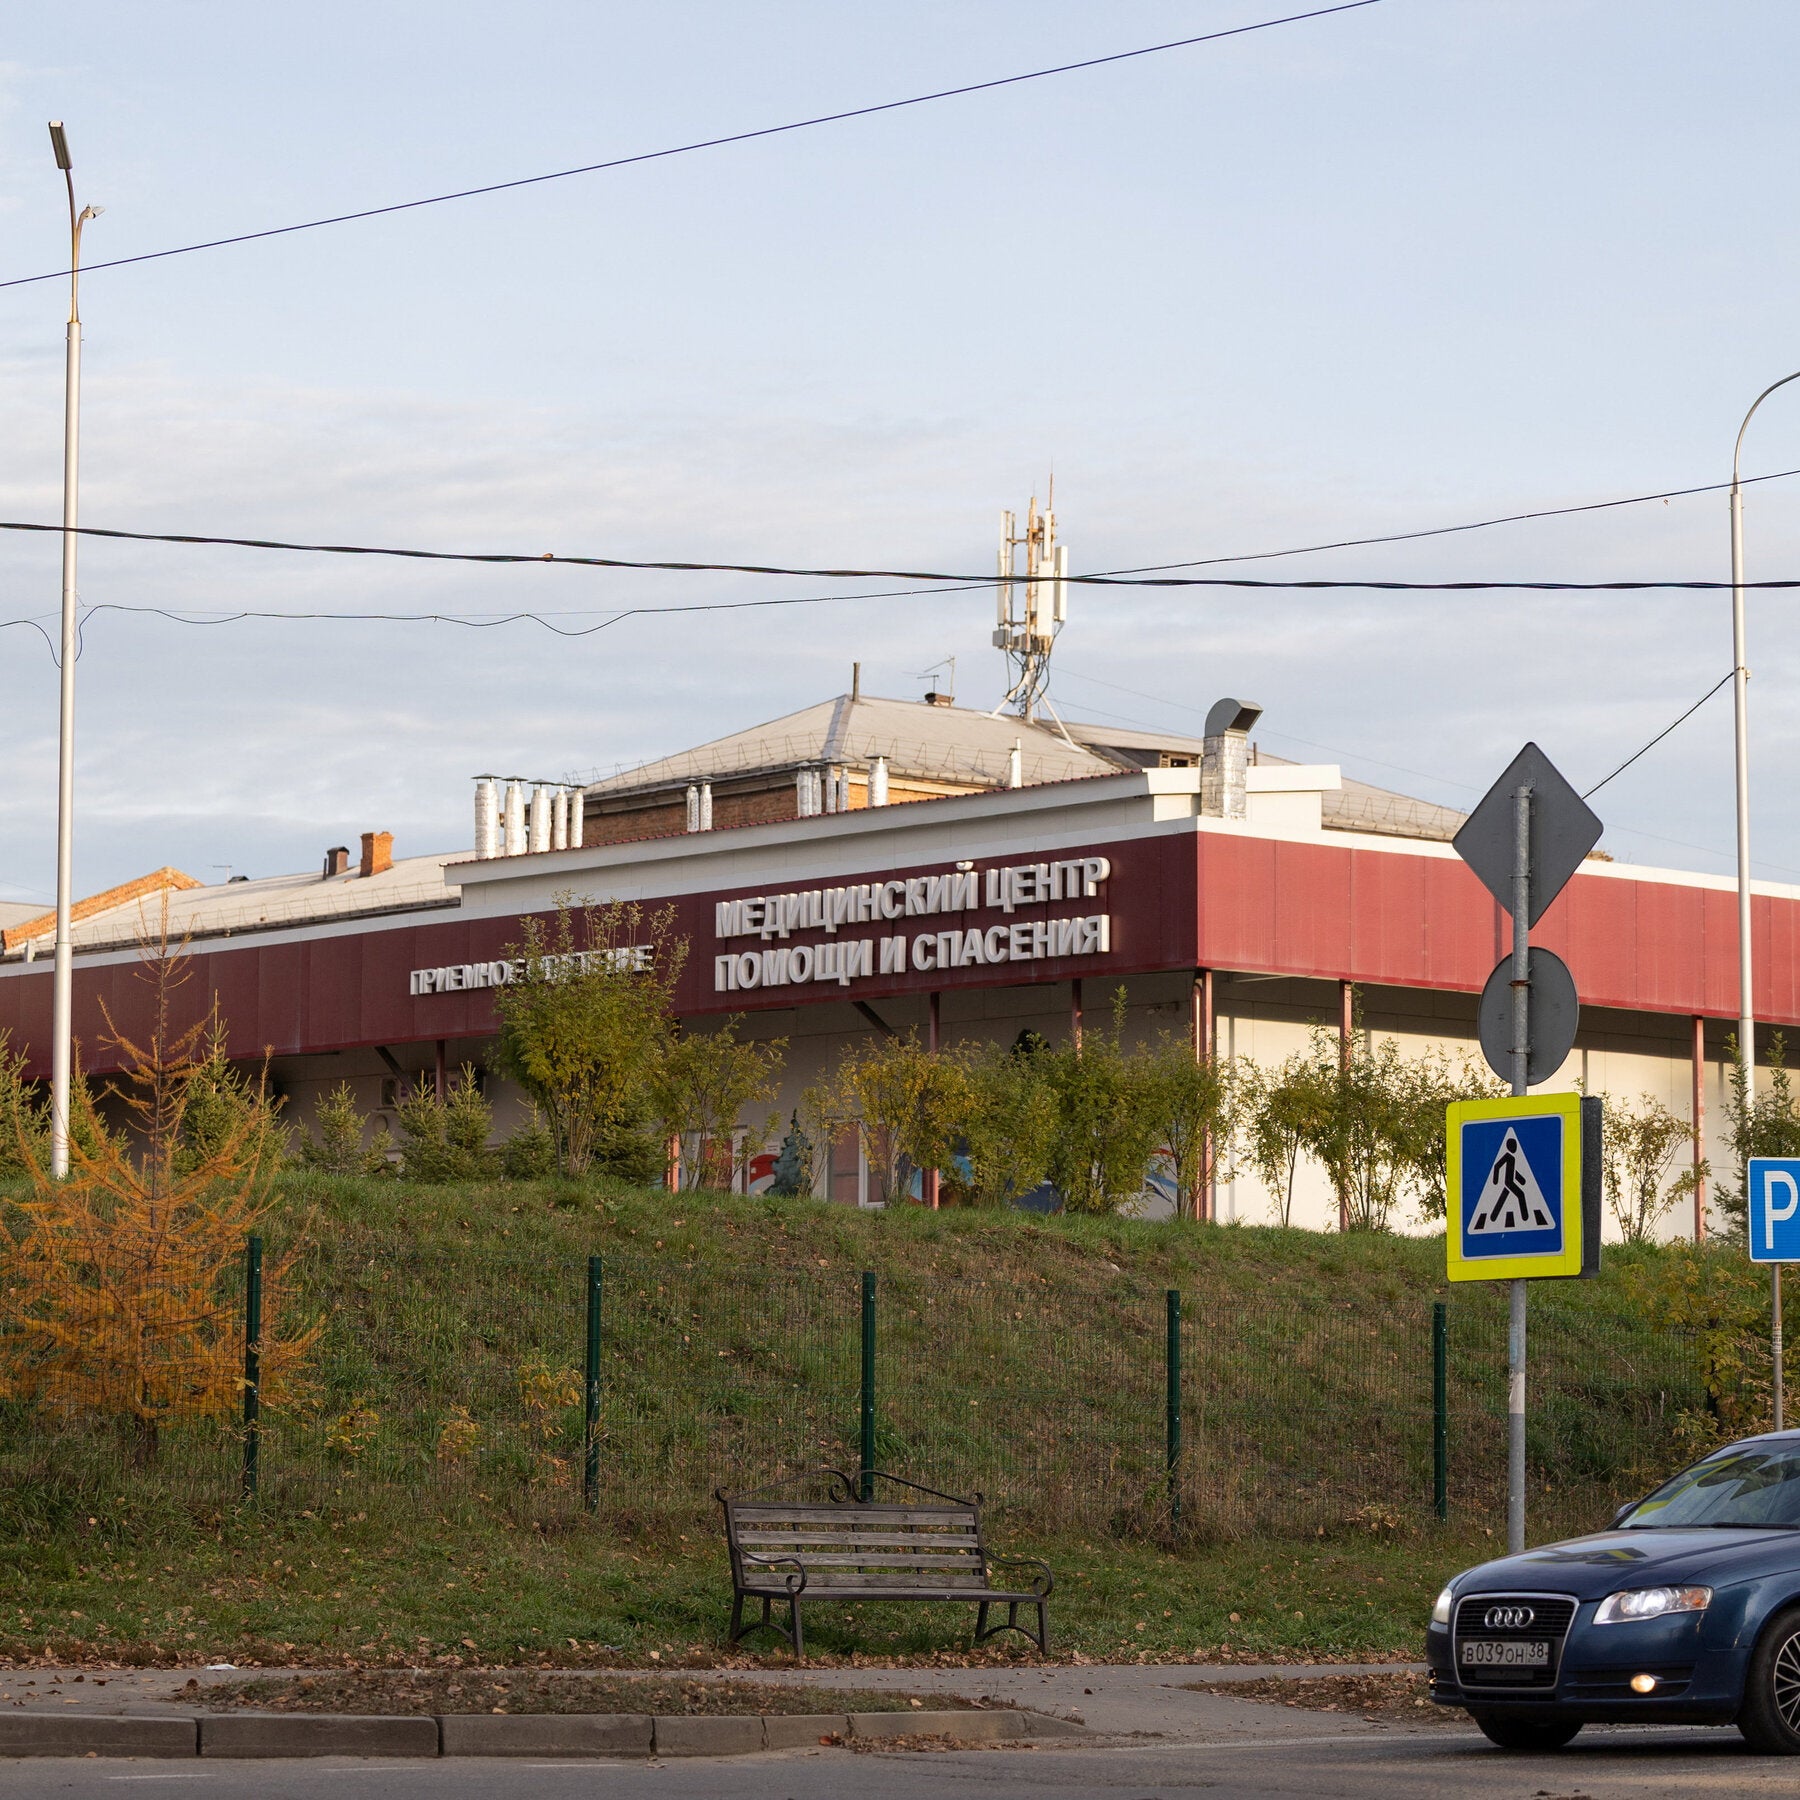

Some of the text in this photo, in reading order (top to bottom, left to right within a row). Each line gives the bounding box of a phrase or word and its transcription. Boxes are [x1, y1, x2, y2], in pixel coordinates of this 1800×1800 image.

[715, 856, 1111, 940] МЕДИЦИНСКИЙ ЦЕНТР
[714, 938, 874, 992] ПОМОЩИ
[879, 935, 907, 974] И
[911, 914, 1110, 971] СПАСЕНИЯ
[1763, 1170, 1799, 1250] P
[1528, 1642, 1545, 1658] 38
